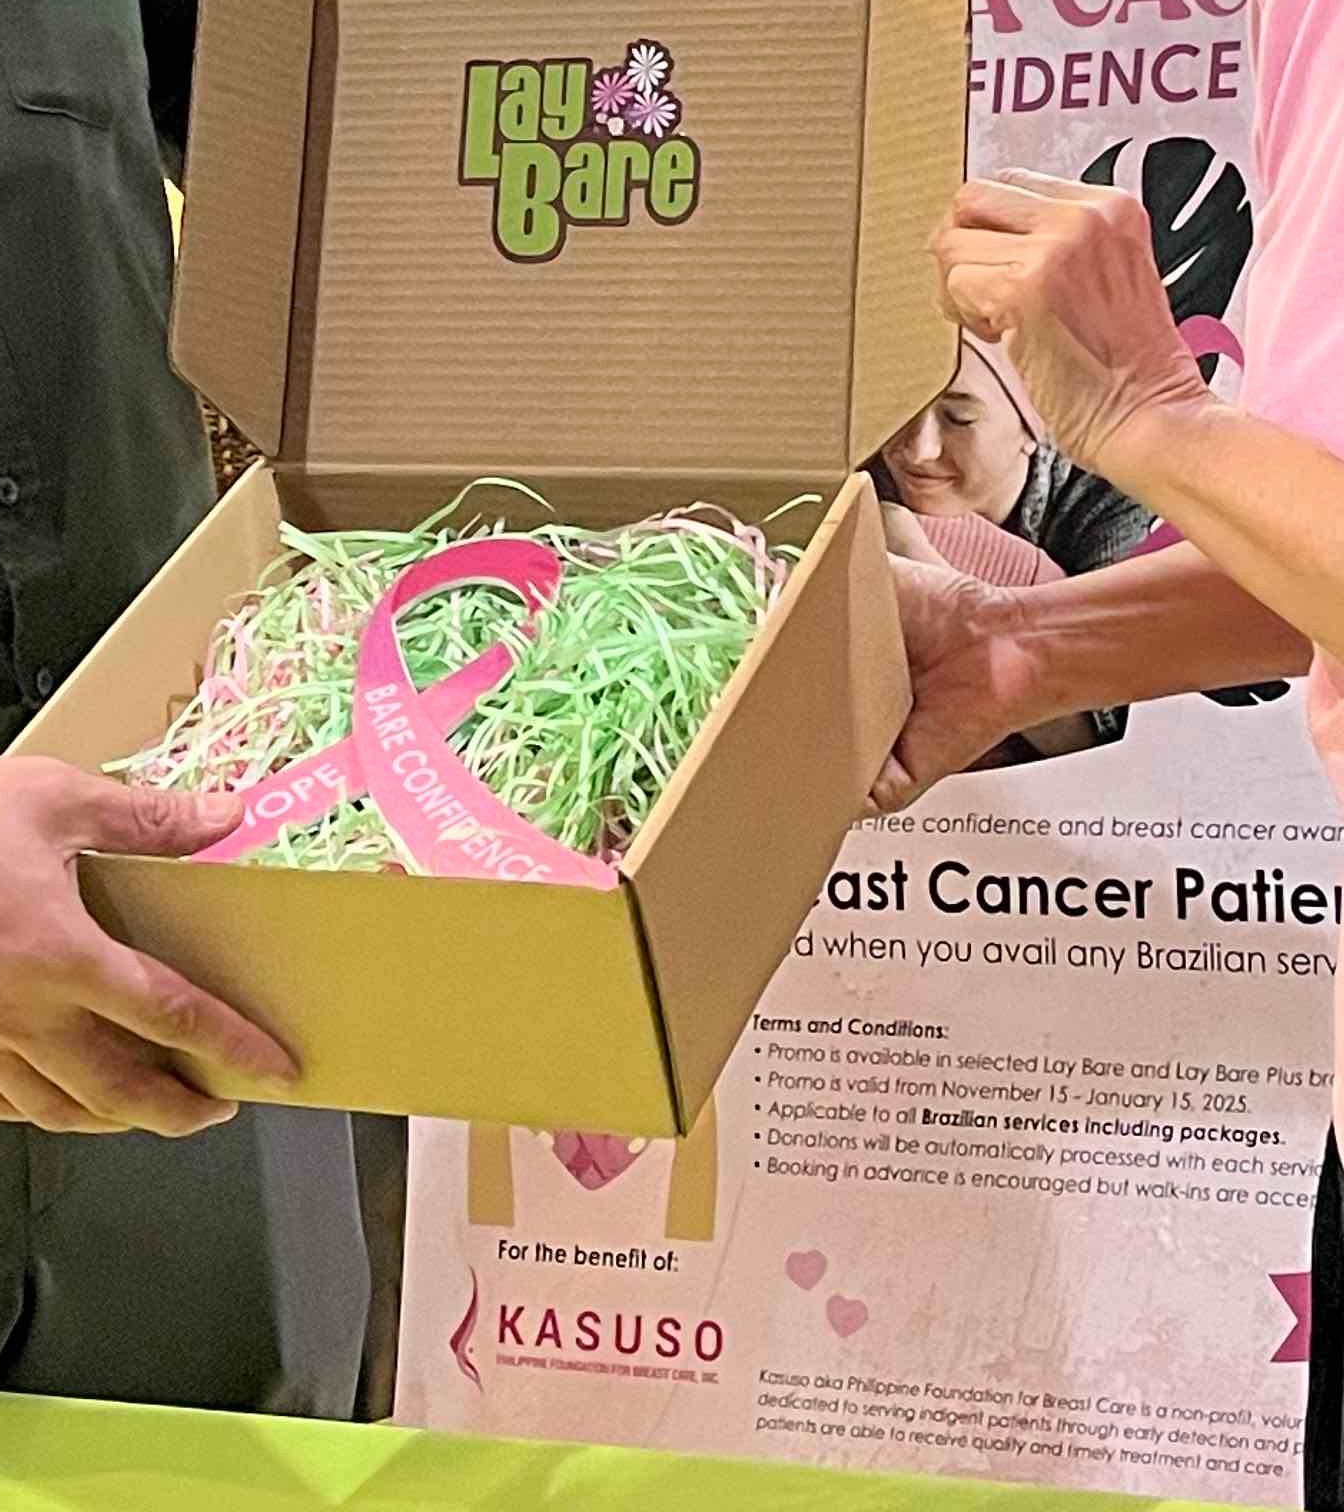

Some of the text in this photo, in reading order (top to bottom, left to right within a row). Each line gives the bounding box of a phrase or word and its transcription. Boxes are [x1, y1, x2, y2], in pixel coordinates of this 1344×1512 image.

[460, 60, 591, 184] Lay
[493, 135, 700, 264] Bare
[365, 683, 416, 752] BARE
[923, 813, 1276, 839] confidence and breast cancer
[929, 861, 1153, 919] Cancer
[823, 931, 906, 960] when
[917, 939, 971, 967] you
[983, 935, 1056, 966] avail
[1067, 944, 1125, 975] any
[1137, 940, 1265, 973] Brazilian
[753, 1014, 949, 1039] Terms and Conditions:
[768, 1043, 1302, 1086] Promo available selected Lay Bare and Lay Bare Plus
[768, 1071, 1252, 1114] Promo valid from November January 2025.
[768, 1101, 1287, 1148] Applicable Brazilian services including packages.
[768, 1128, 1263, 1175] Donations automatically processed with each
[768, 1157, 1248, 1204] Booking advance encouraged but walk-ins are
[498, 1240, 678, 1272] For the benefit of:
[498, 1304, 723, 1362] KASUSO
[759, 1369, 1136, 1415] Kasuso Philippine Foundation Breast Care
[758, 1392, 1249, 1449] dedicated through early detection
[1120, 1448, 1201, 1469] treatment
